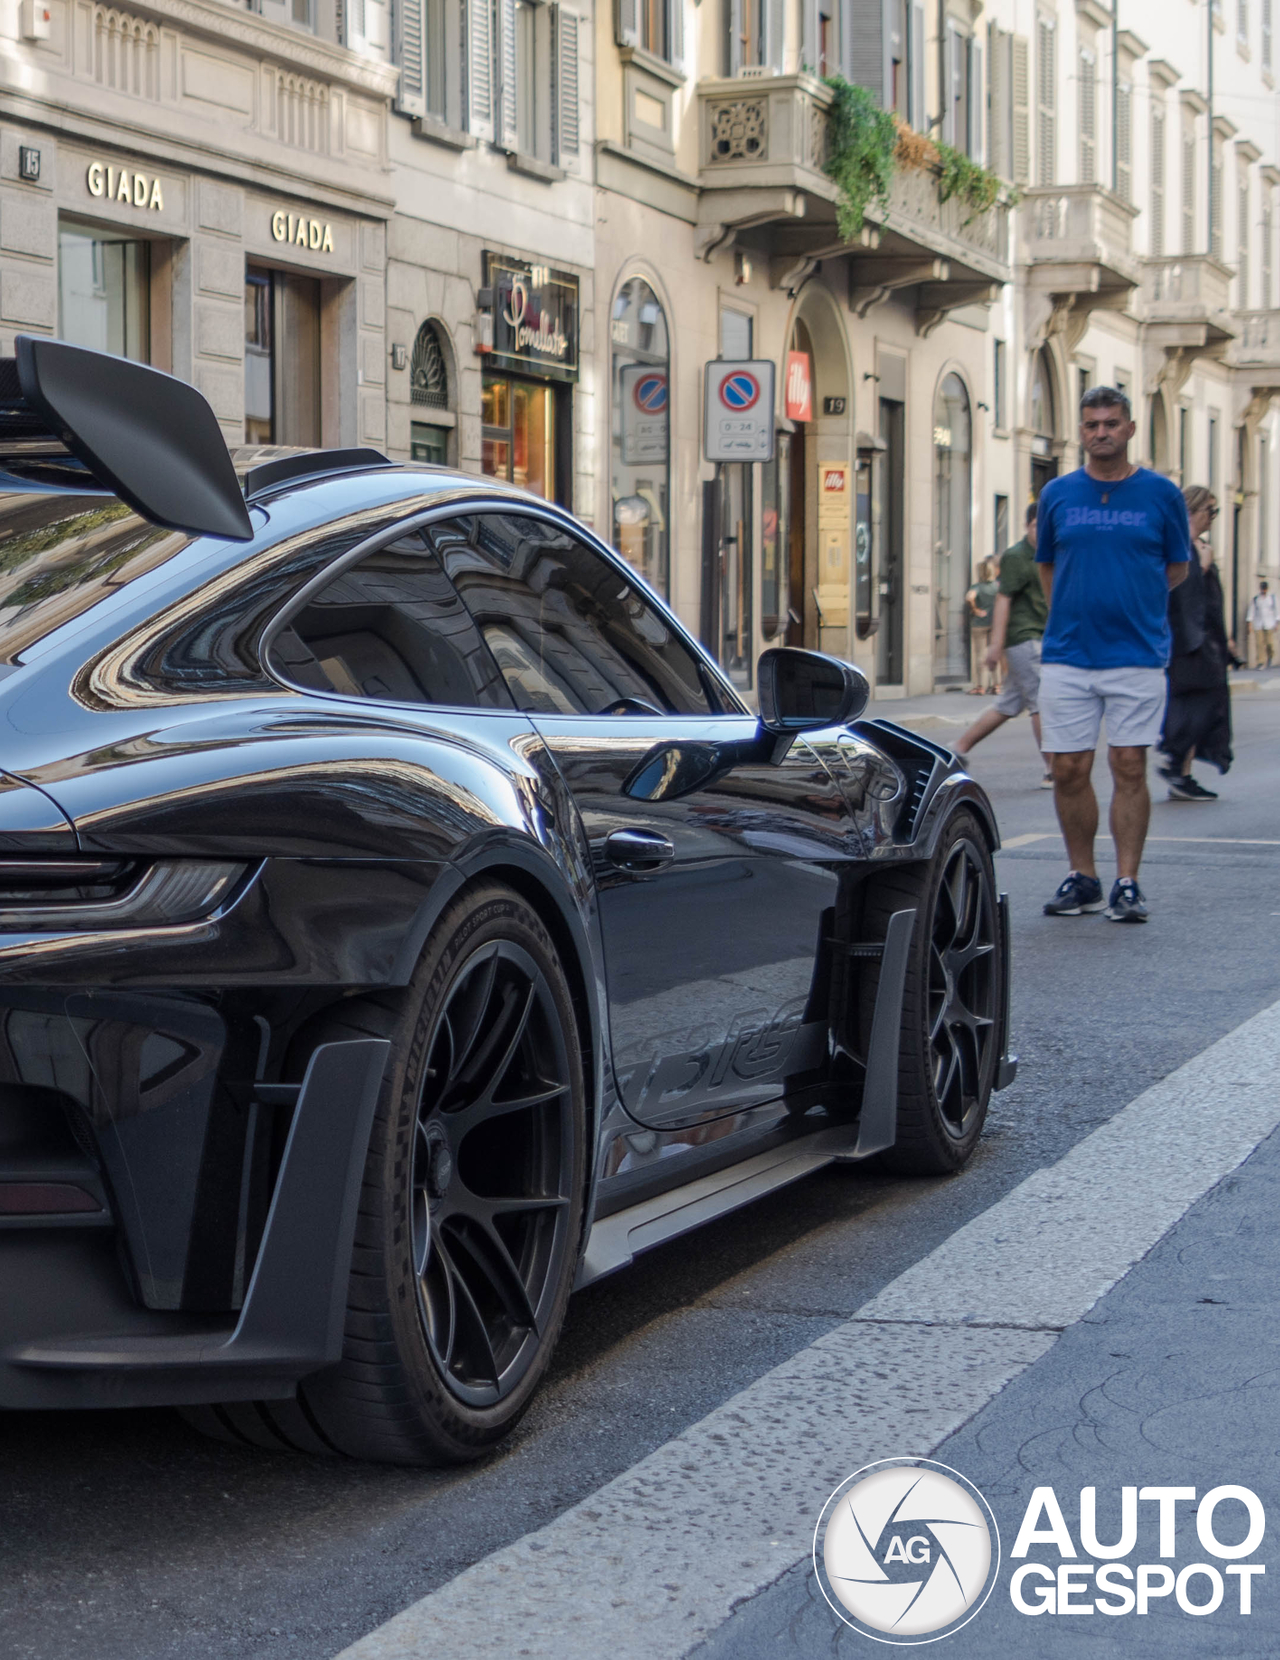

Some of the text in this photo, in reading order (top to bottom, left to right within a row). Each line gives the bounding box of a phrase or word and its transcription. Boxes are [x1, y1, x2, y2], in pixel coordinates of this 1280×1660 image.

[26, 149, 39, 175] 15
[87, 161, 164, 211] GIADA
[271, 210, 335, 254] GIADA
[503, 280, 568, 356] Pomellato
[788, 361, 810, 415] illy
[829, 399, 844, 412] 19
[824, 472, 844, 490] illy
[454, 923, 472, 949] PILOT
[472, 907, 492, 927] SPORT
[493, 904, 505, 914] CUP
[407, 948, 452, 1085] MICHELIN
